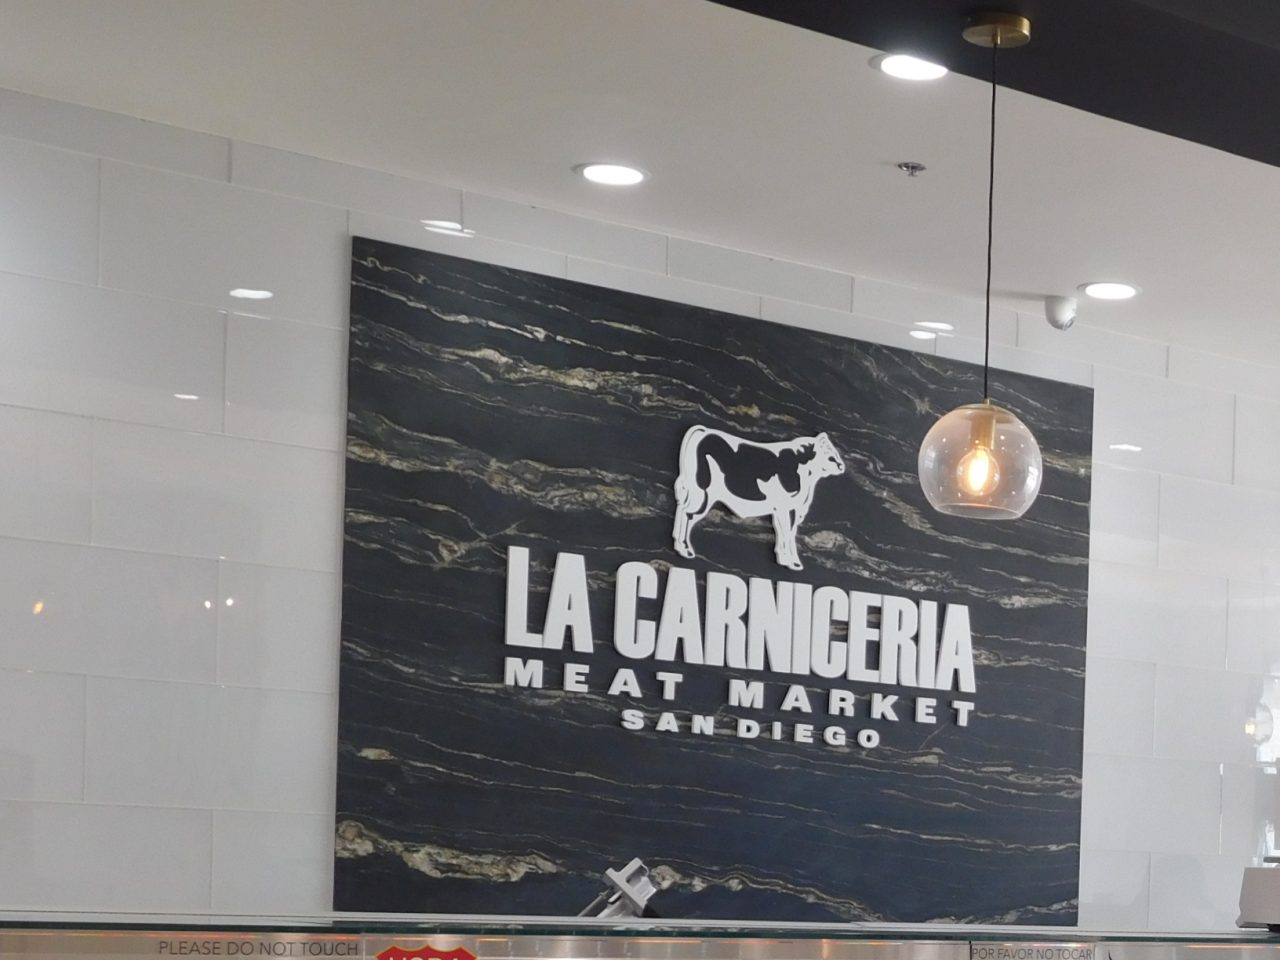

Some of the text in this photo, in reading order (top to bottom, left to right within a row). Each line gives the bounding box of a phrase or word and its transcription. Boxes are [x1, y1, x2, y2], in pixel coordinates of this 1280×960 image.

[505, 545, 977, 694] LA CARNICERIA
[504, 656, 975, 728] MEAT MARKET
[620, 708, 881, 749] SAN DIEGO
[159, 941, 359, 957] PLEASE DO NOT TOUCH
[972, 948, 1093, 960] POR FAVOR NO TOCAR
